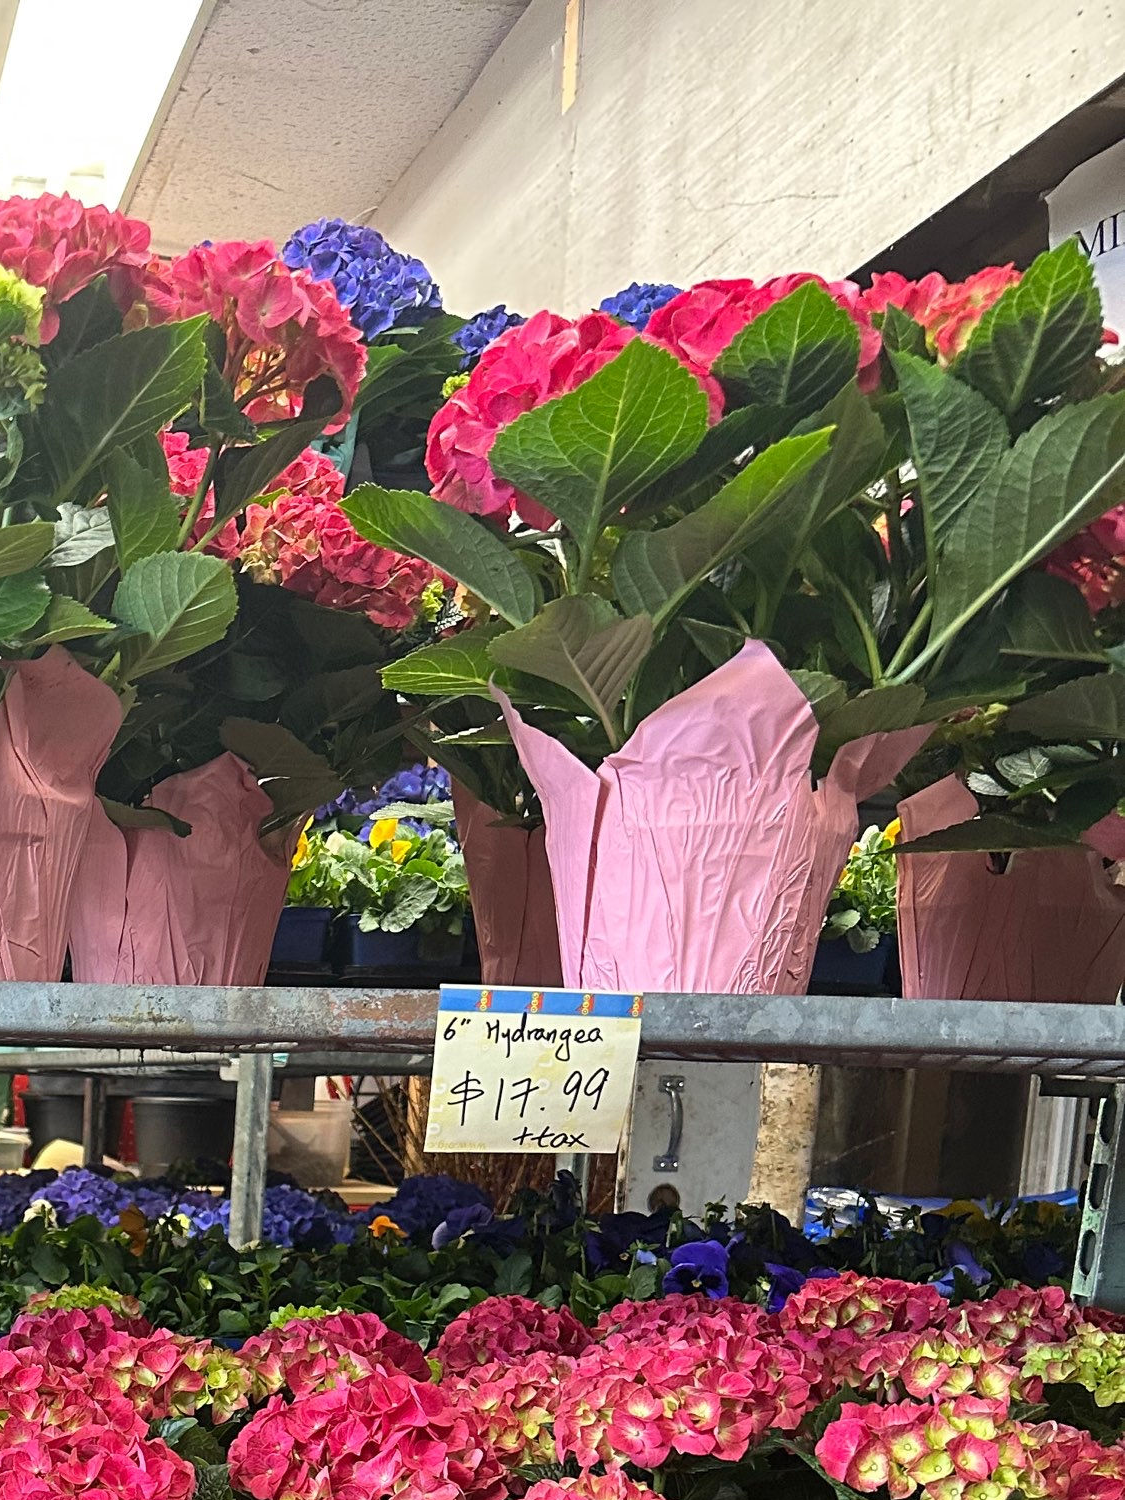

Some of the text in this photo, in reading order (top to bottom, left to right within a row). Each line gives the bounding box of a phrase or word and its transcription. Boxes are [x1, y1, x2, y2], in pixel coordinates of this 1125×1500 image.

[486, 1012, 603, 1061] Hydrangea
[447, 1068, 609, 1127] $17.99
[512, 1126, 590, 1149] +tax
